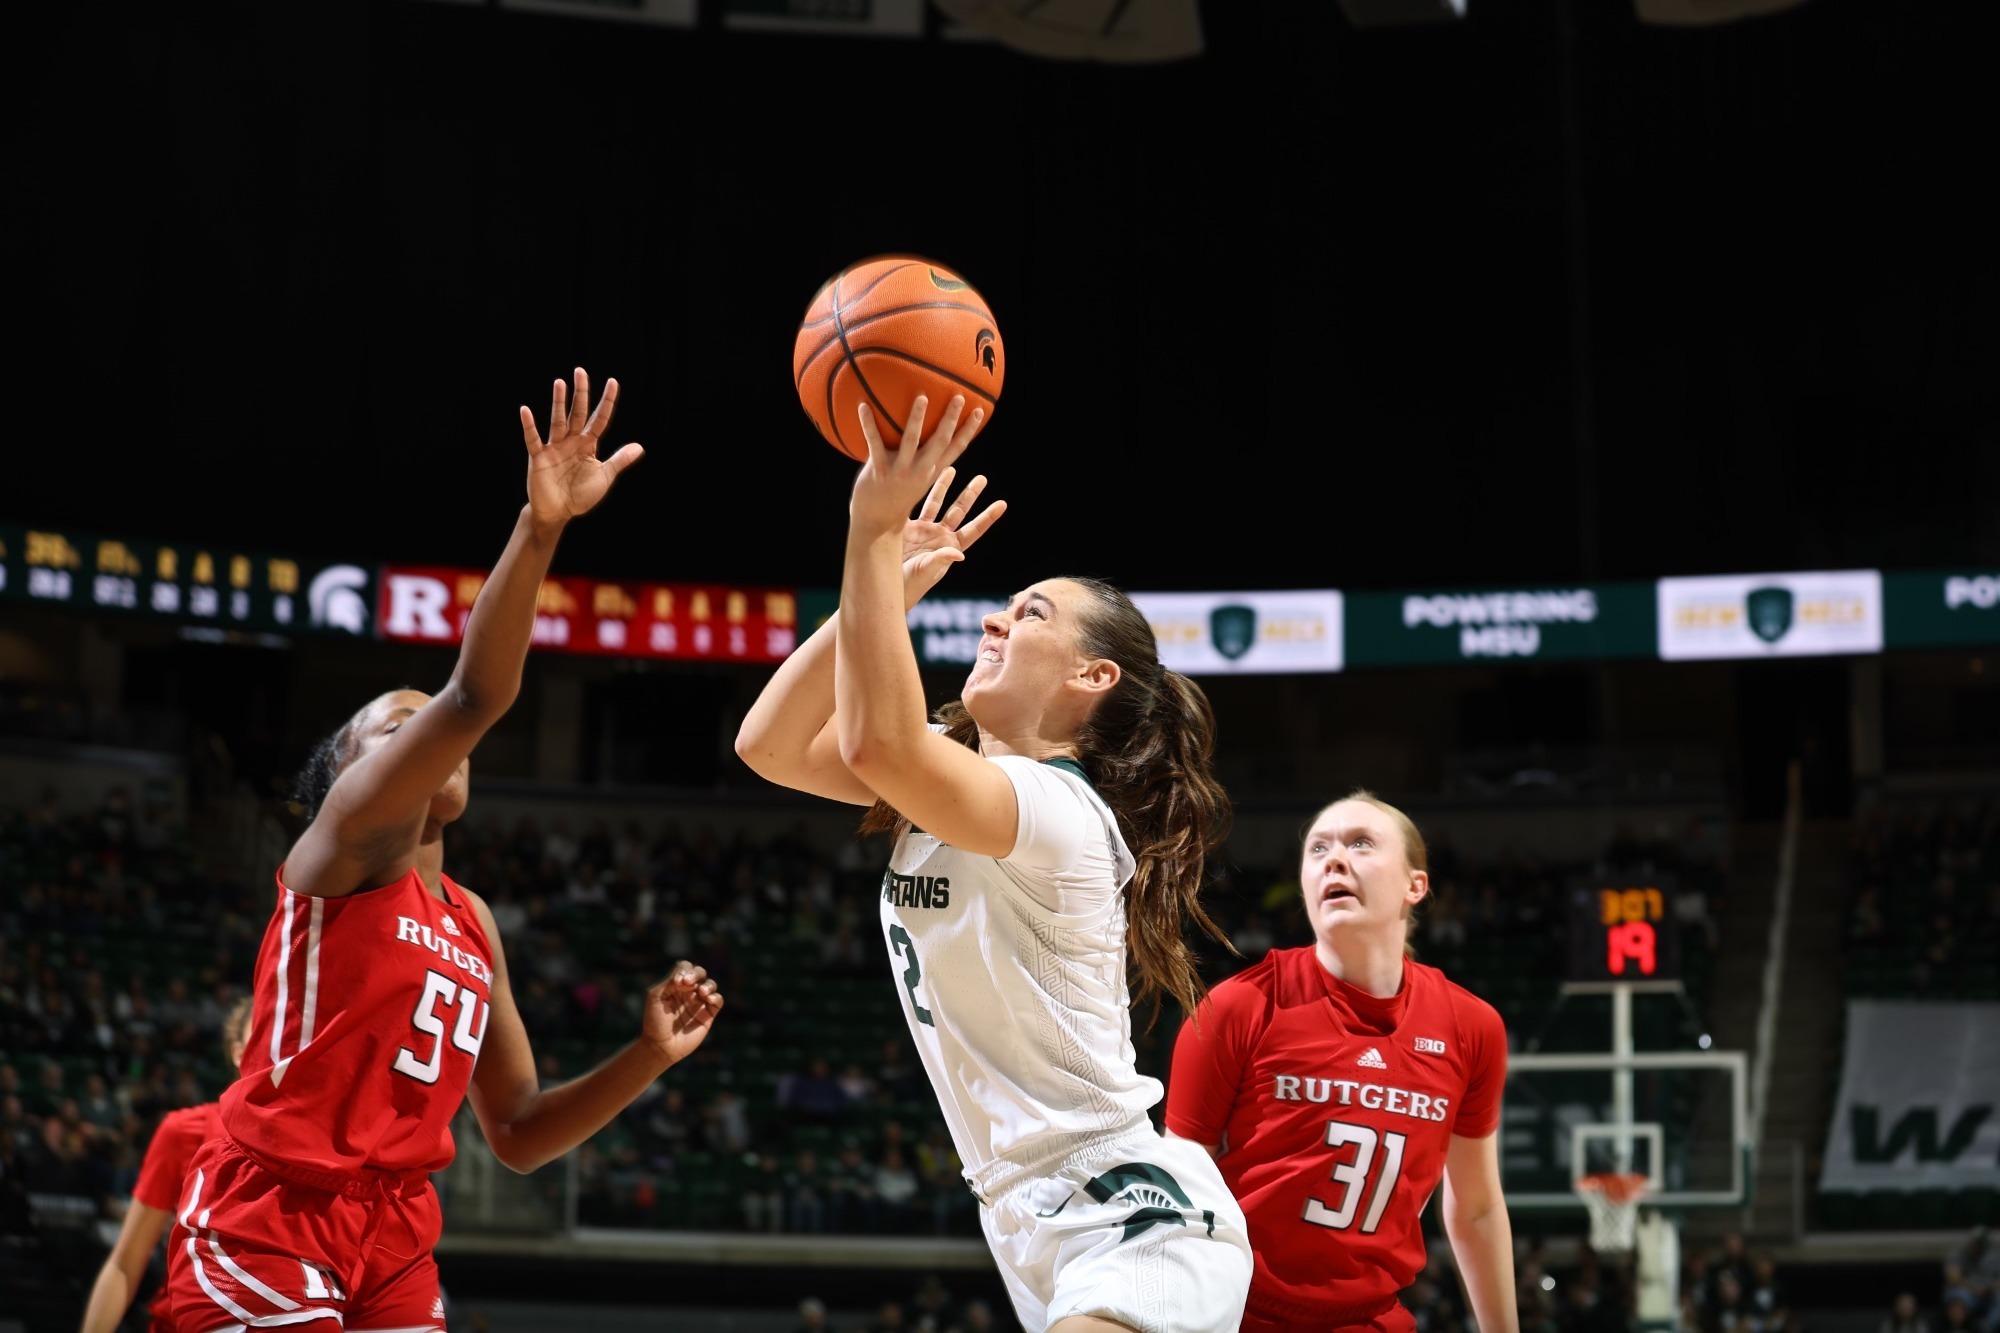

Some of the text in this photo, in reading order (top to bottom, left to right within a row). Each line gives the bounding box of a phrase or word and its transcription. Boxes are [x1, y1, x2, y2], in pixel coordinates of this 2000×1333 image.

[387, 574, 453, 638] R
[1403, 590, 1598, 628] POWERING
[1944, 575, 2000, 610] PO
[925, 631, 981, 662] MS
[1460, 624, 1540, 657] MSU
[396, 916, 493, 988] RUTGE
[889, 924, 935, 1027] 2
[390, 967, 490, 1086] 54
[1274, 1074, 1449, 1122] RUTGERS
[1850, 1104, 2000, 1164] W
[1302, 1119, 1407, 1235] 31
